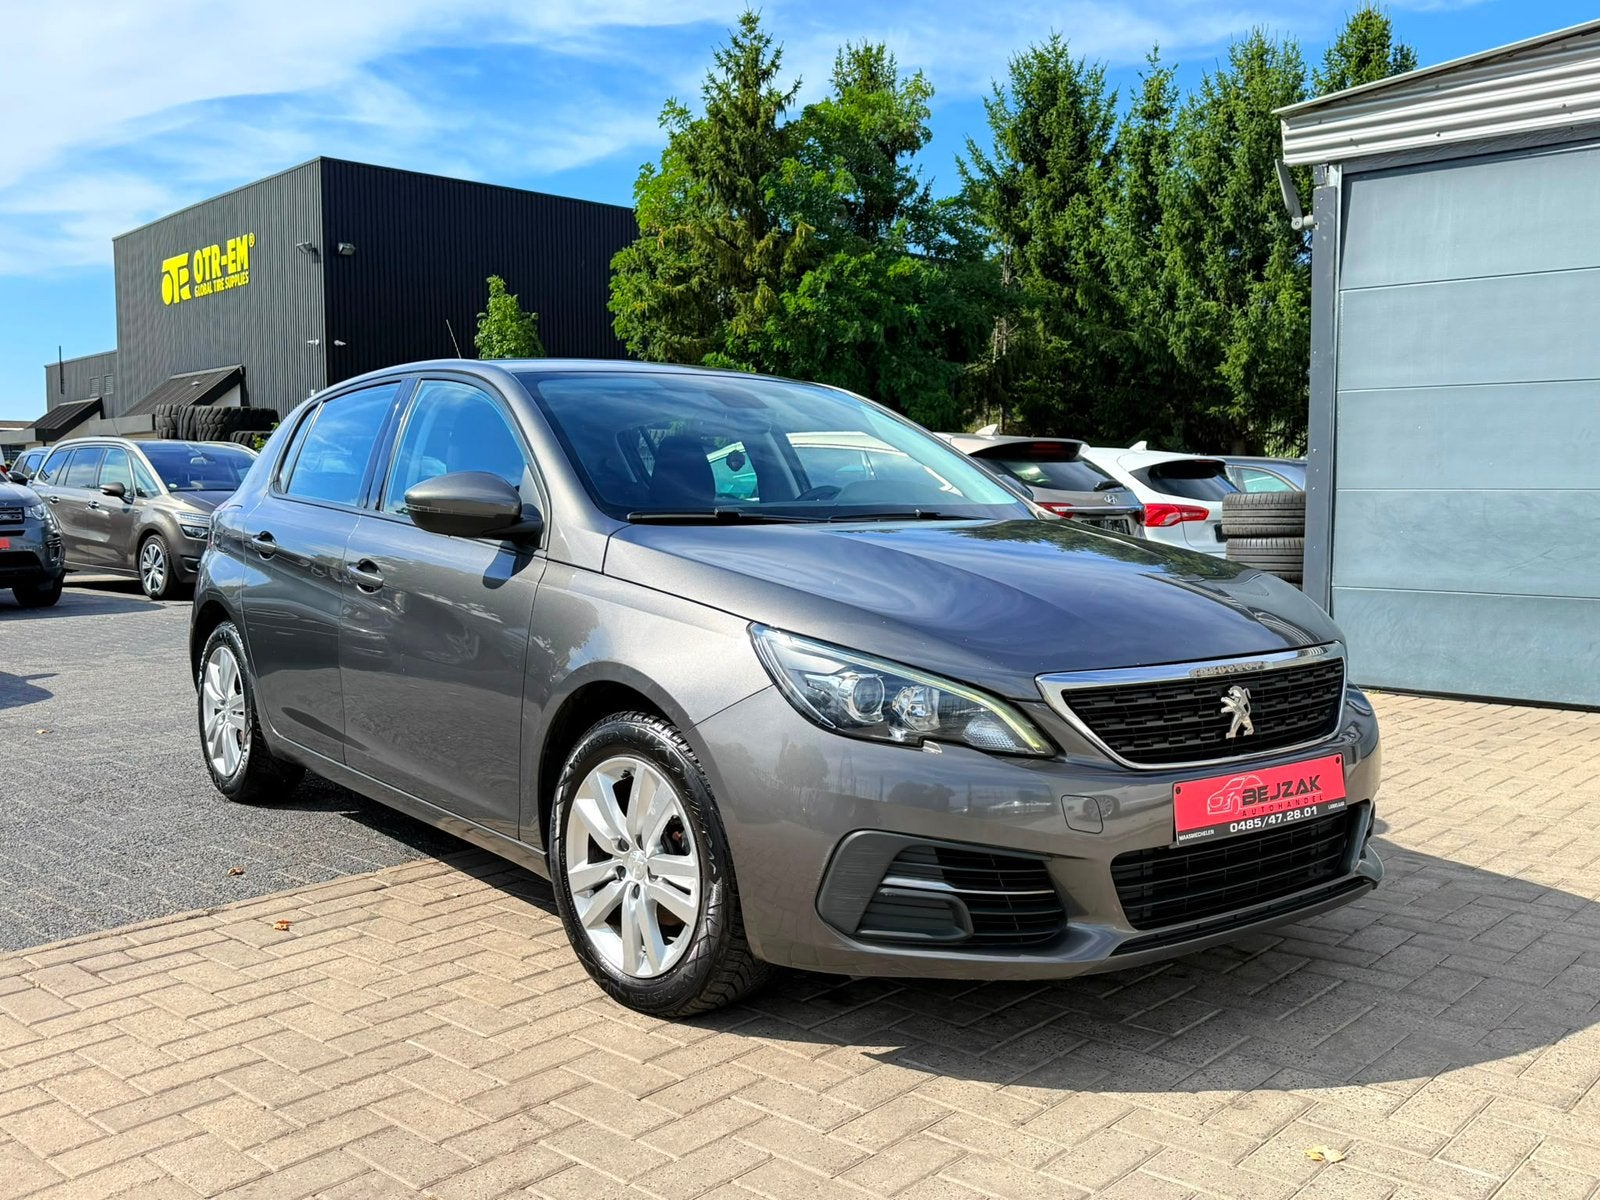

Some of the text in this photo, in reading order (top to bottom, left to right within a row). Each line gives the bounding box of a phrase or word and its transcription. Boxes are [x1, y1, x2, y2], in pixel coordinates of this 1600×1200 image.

[1242, 775, 1321, 806] BEJZAK
[1229, 805, 1318, 833] 0485/47.28.01
[1242, 794, 1323, 817] AUTOHANDEL
